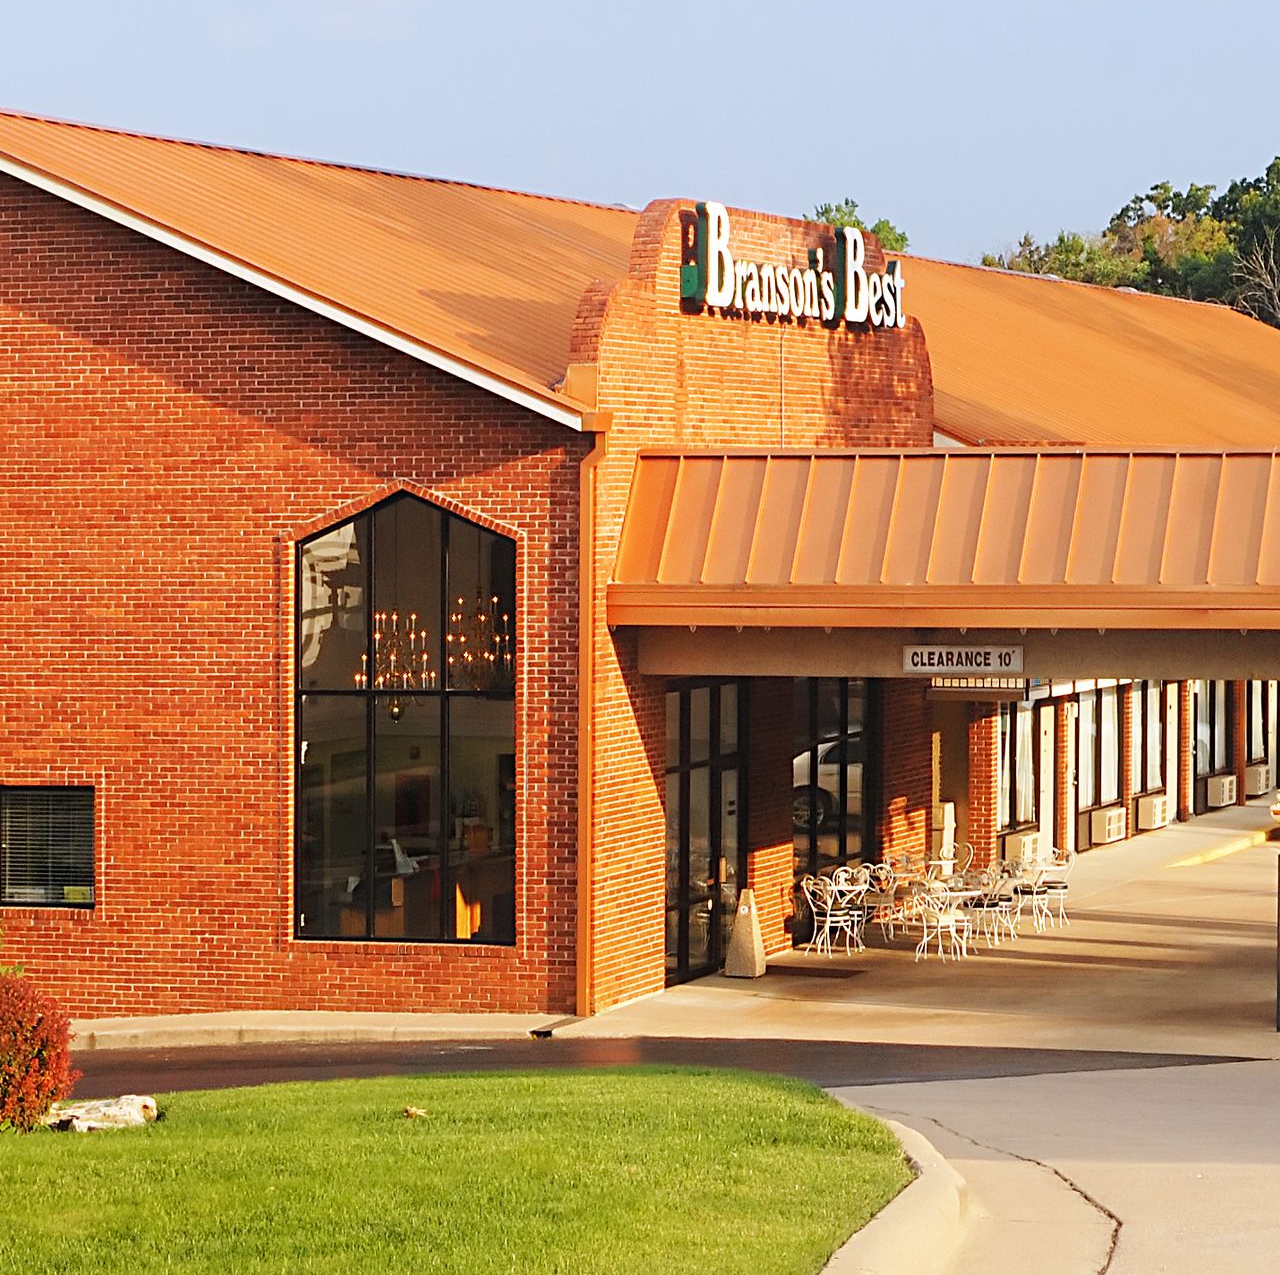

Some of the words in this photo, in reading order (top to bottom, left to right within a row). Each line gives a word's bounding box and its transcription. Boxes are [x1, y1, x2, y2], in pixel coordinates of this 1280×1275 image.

[706, 201, 835, 321] Branson's
[844, 225, 906, 329] Best
[911, 651, 992, 667] CLEARANCE
